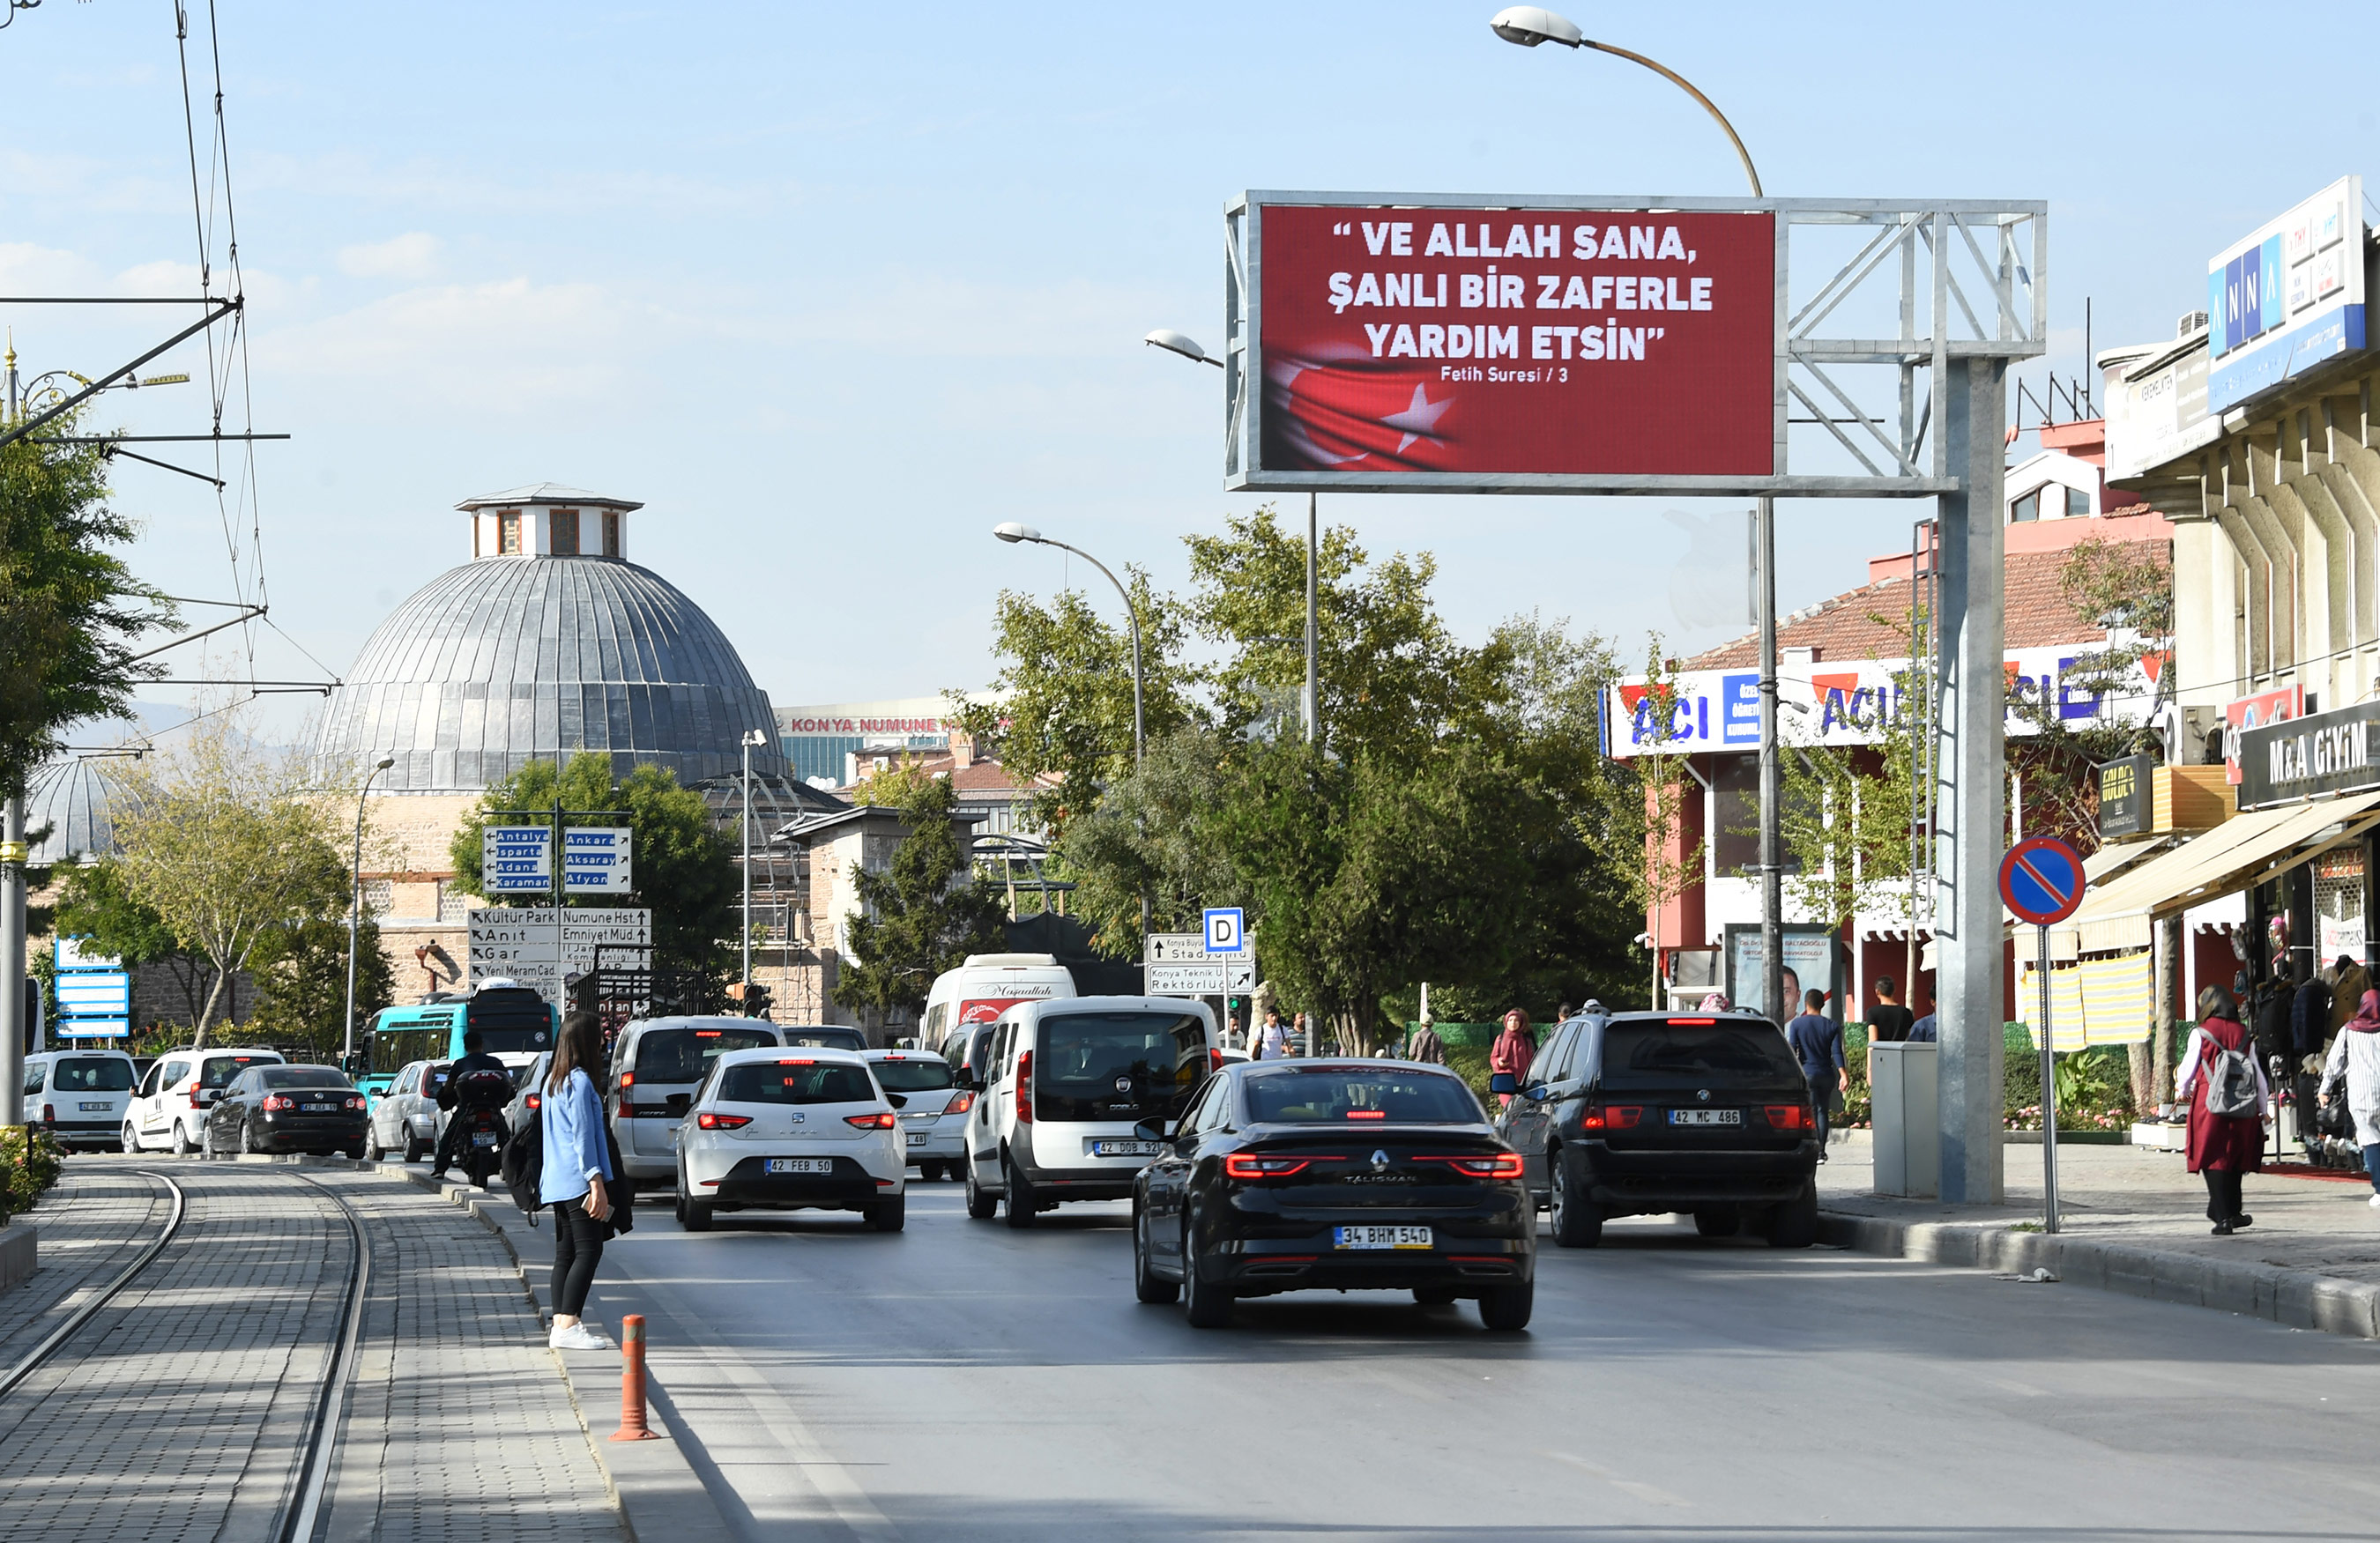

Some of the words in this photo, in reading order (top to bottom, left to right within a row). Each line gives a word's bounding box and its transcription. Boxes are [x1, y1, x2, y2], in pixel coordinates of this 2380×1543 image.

[1361, 222, 1412, 256] VE
[1424, 224, 1560, 258] ALLAH
[1573, 226, 1697, 264] SANA,
[1328, 272, 1447, 314] ŞANLI
[1460, 265, 1525, 308] BİR
[1536, 276, 1714, 310] ZAFERLE
[1364, 323, 1519, 360] YARDIM
[1531, 318, 1665, 360] ETSİN”
[1441, 366, 1483, 382] Fetih
[1487, 366, 1541, 382] Suresi
[1558, 368, 1568, 382] 3
[1732, 702, 1760, 718] ÖĞRETİ
[792, 718, 853, 732] KONYA
[859, 718, 937, 732] NUMUNE
[1727, 723, 1761, 737] KURUML
[496, 832, 549, 843] Antalya
[566, 835, 615, 845] Ankara
[496, 846, 542, 857] Isparta
[566, 855, 616, 866] Aksaray
[496, 863, 538, 872] Adana
[496, 878, 549, 886] Karaman
[566, 874, 608, 885] Afyon
[484, 910, 523, 924] Kültür
[527, 910, 554, 924] Park
[563, 910, 612, 924] Numune
[614, 911, 636, 924] Hst.
[485, 929, 526, 941] Anıt
[563, 928, 607, 943] Emniyet
[610, 927, 636, 940] Müd.
[1216, 919, 1231, 942] D
[574, 944, 635, 953] Janarma
[1166, 938, 1185, 948] Konya
[485, 946, 519, 959] Gar
[567, 953, 630, 962] Komuanlığı
[485, 965, 503, 976] Yeni
[506, 965, 537, 976] Meram
[538, 964, 556, 976] Cad.
[1152, 969, 1180, 979] Konya
[1184, 968, 1213, 978] Teknik
[1216, 967, 1236, 978] Üv.
[1676, 1111, 1688, 1123] 42
[1696, 1111, 1710, 1123] MC
[1718, 1111, 1738, 1123] 486
[1100, 1143, 1113, 1153] 42
[1145, 1143, 1157, 1153] 92
[771, 1161, 784, 1171] 42
[792, 1161, 810, 1171] FEB
[817, 1161, 830, 1171] 50
[1344, 1175, 1417, 1183] TALISMAN
[1343, 1228, 1362, 1243] 34
[1368, 1228, 1395, 1243] BHM
[1400, 1228, 1427, 1243] 540
